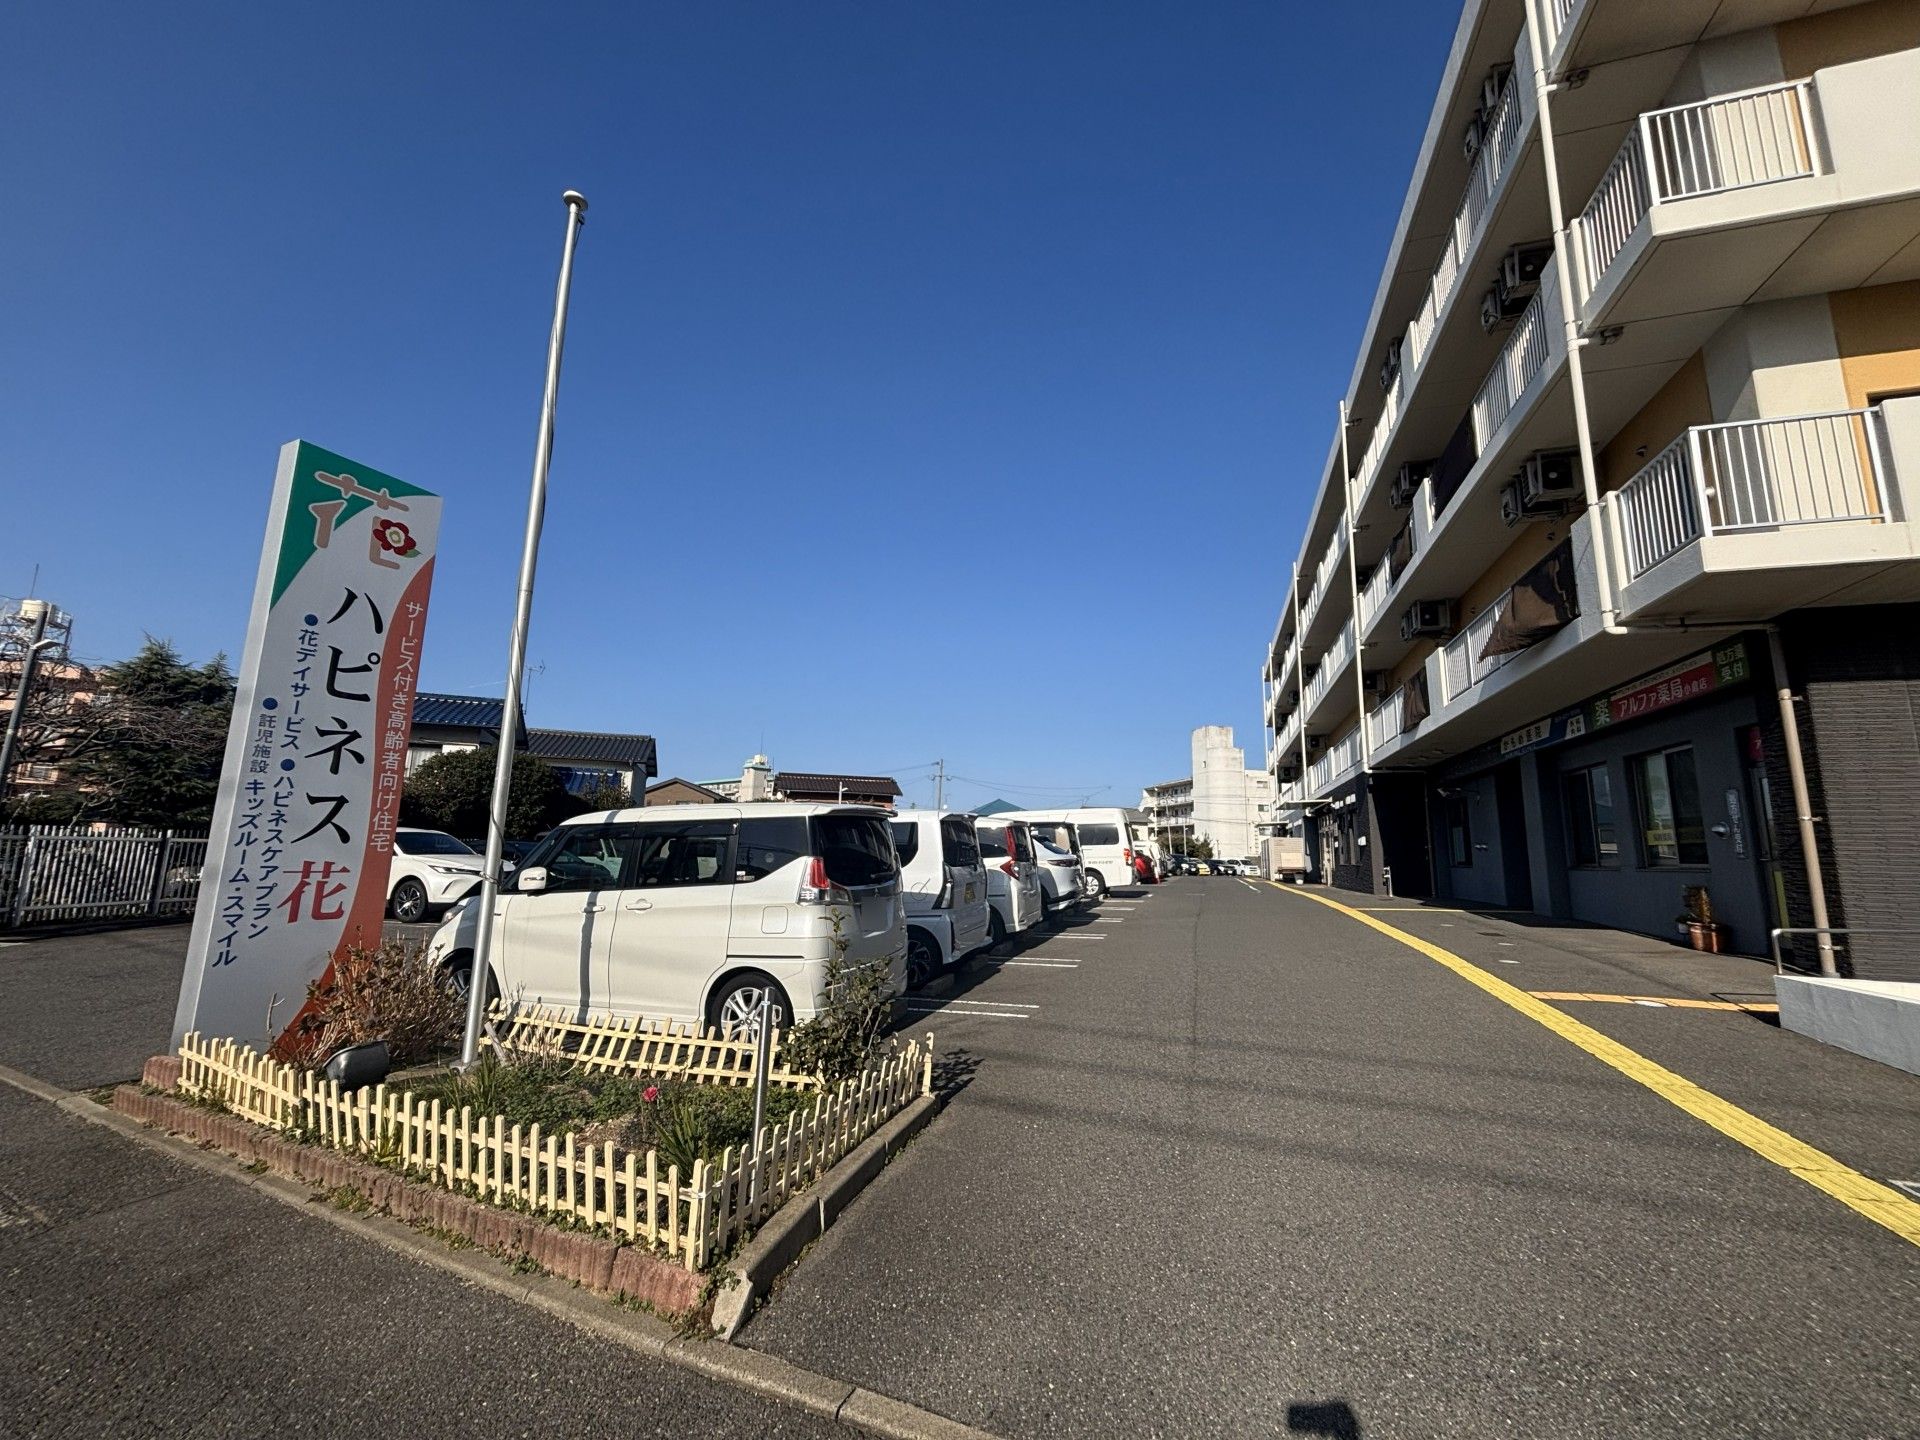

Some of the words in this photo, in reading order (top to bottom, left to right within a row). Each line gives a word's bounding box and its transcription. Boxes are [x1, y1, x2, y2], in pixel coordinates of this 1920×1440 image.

[250, 714, 276, 775] 託児施設
[280, 629, 319, 750] 花デイサービス
[370, 602, 423, 852] サービス付き高齢者向け住宅
[248, 776, 294, 940] ハピネスケアプラン
